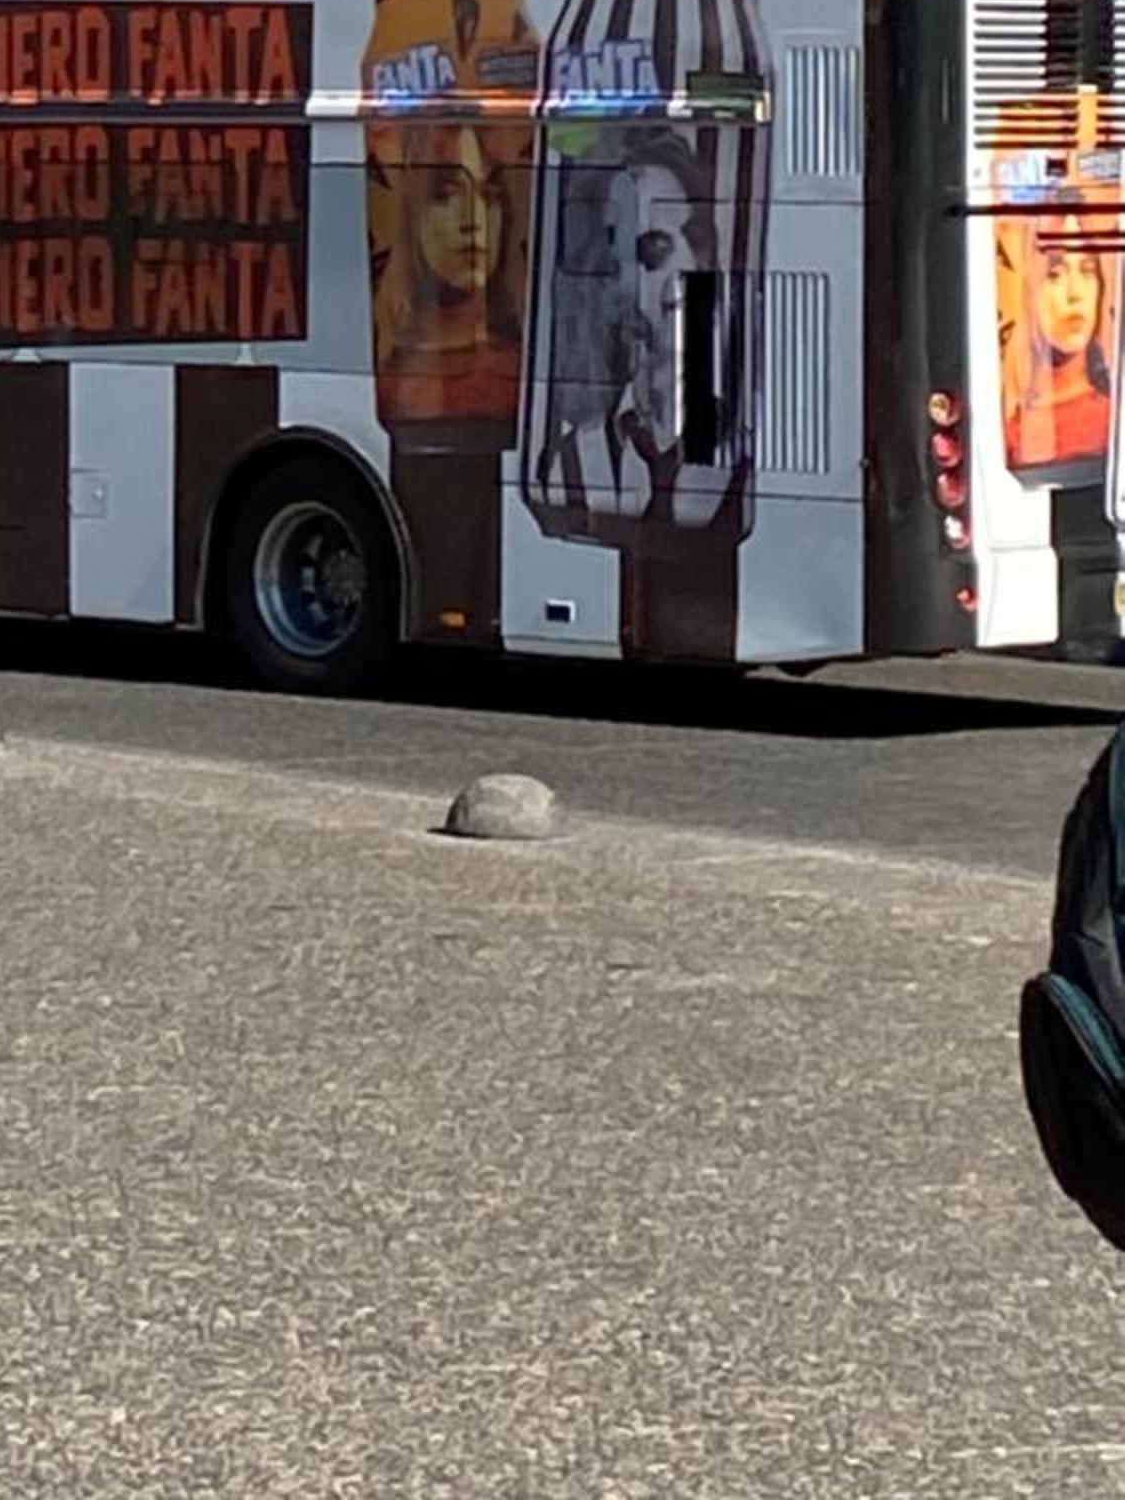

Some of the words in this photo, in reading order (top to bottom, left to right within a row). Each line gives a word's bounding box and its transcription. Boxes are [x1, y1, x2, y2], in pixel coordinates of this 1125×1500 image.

[127, 6, 297, 105] FANTA
[127, 125, 299, 225] FANTA
[132, 237, 300, 339] FANTA
